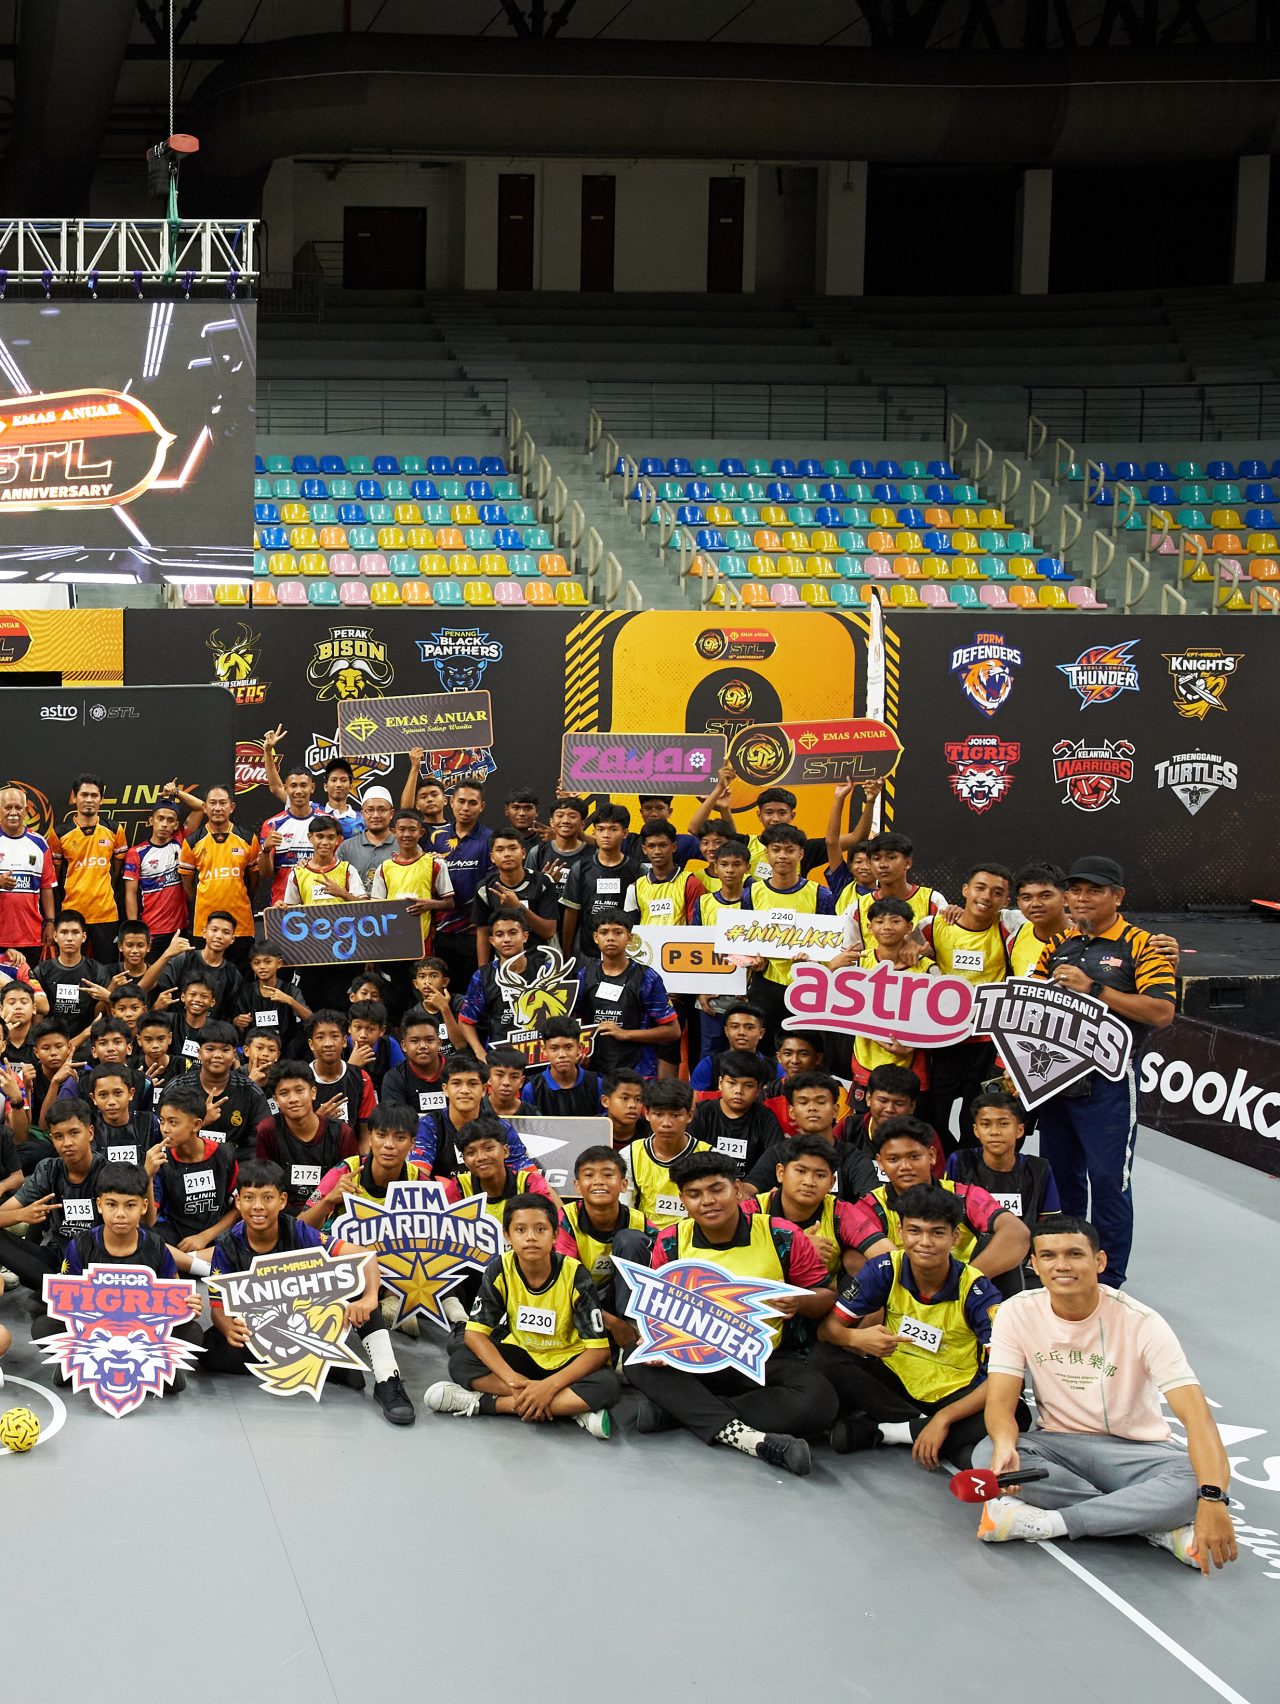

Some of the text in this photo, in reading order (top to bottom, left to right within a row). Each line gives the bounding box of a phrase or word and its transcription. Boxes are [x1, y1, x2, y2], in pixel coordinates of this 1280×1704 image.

[12, 404, 122, 428] EMAS ANUAR
[1, 483, 112, 500] ANNIVERSARY
[334, 630, 368, 639] PERAK
[440, 636, 482, 646] BLACK
[318, 641, 386, 661] BISON
[424, 644, 499, 658] PANTHERS
[730, 643, 765, 655] STL
[951, 646, 1021, 670] DEFENDERS
[1171, 656, 1235, 672] KNIGHTS
[1066, 666, 1137, 688] THUNDER
[40, 704, 140, 718] astro STL
[385, 710, 487, 729] EMAS ANUAR
[823, 730, 887, 742] EMAS ANUAR
[968, 738, 997, 746] JOHOR
[947, 744, 1019, 761] TIGRIS
[1077, 750, 1111, 759] KELANTAN
[1173, 753, 1222, 763] TERENGGANU
[802, 755, 876, 780] STL
[1057, 761, 1131, 781] WARRIORS
[1155, 761, 1238, 789] TURTLES
[758, 867, 772, 875] 224
[651, 903, 671, 912] 2242
[771, 913, 794, 921] 2240
[281, 911, 398, 961] Gegar
[955, 954, 981, 967] 2225
[58, 988, 78, 997] 2161
[790, 963, 971, 1026] astro
[1012, 983, 1098, 1020] TERENGGANU
[55, 1004, 81, 1014] STL
[257, 1014, 277, 1023] 2152
[512, 1032, 539, 1043] NEGERI
[977, 989, 1124, 1072] TURTLES
[185, 1043, 198, 1053] 213
[420, 1095, 444, 1106] 2123
[719, 1141, 744, 1154] 2121
[110, 1150, 135, 1161] 2122
[293, 1169, 319, 1181] 2175
[186, 1176, 212, 1190] 2191
[186, 1192, 217, 1201] KLINIK
[391, 1187, 443, 1211] ATM
[66, 1204, 91, 1216] 2135
[184, 1200, 220, 1215] STL
[658, 1200, 685, 1212] 2215
[62, 1220, 93, 1229] KLINIK
[340, 1213, 498, 1255] GUARDIANS
[256, 1258, 324, 1277] KPT-MASUM
[596, 1260, 612, 1271] 223
[93, 1273, 149, 1287] JOHOR
[228, 1263, 356, 1306] KNIGHTS
[52, 1282, 188, 1316] TIGRIS
[667, 1286, 755, 1334] KUALA LUMPUR
[519, 1312, 553, 1328] 2230
[633, 1275, 761, 1367] THUNDER
[902, 1322, 937, 1345] 2233
[1033, 1349, 1119, 1378] 乒乓俱樂部
